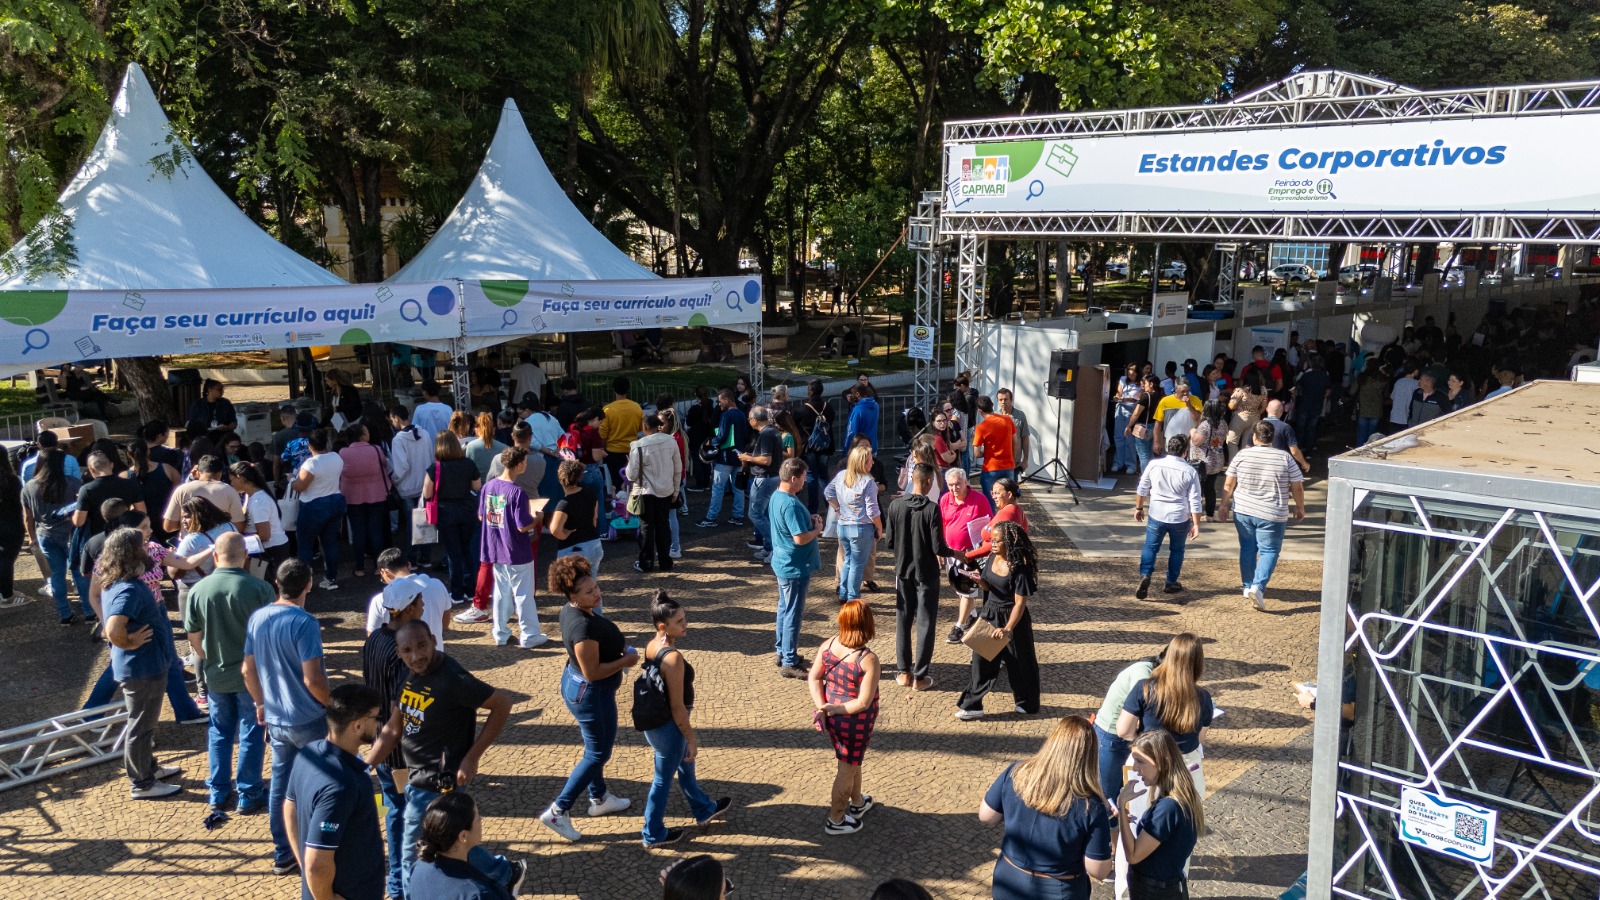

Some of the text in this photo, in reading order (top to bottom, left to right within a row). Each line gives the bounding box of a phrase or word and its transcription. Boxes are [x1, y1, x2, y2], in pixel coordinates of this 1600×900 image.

[1138, 139, 1507, 174] Estandes Corporativos
[962, 184, 1005, 194] CAPIVARI
[1275, 179, 1313, 187] Feirão do
[542, 294, 713, 315] Faça seu currículo aqui!
[92, 303, 376, 335] Faça seu currículo aqui!
[1409, 799, 1426, 808] QUER
[1408, 804, 1449, 819] FAZER PARTE
[1419, 812, 1437, 821] TIME?
